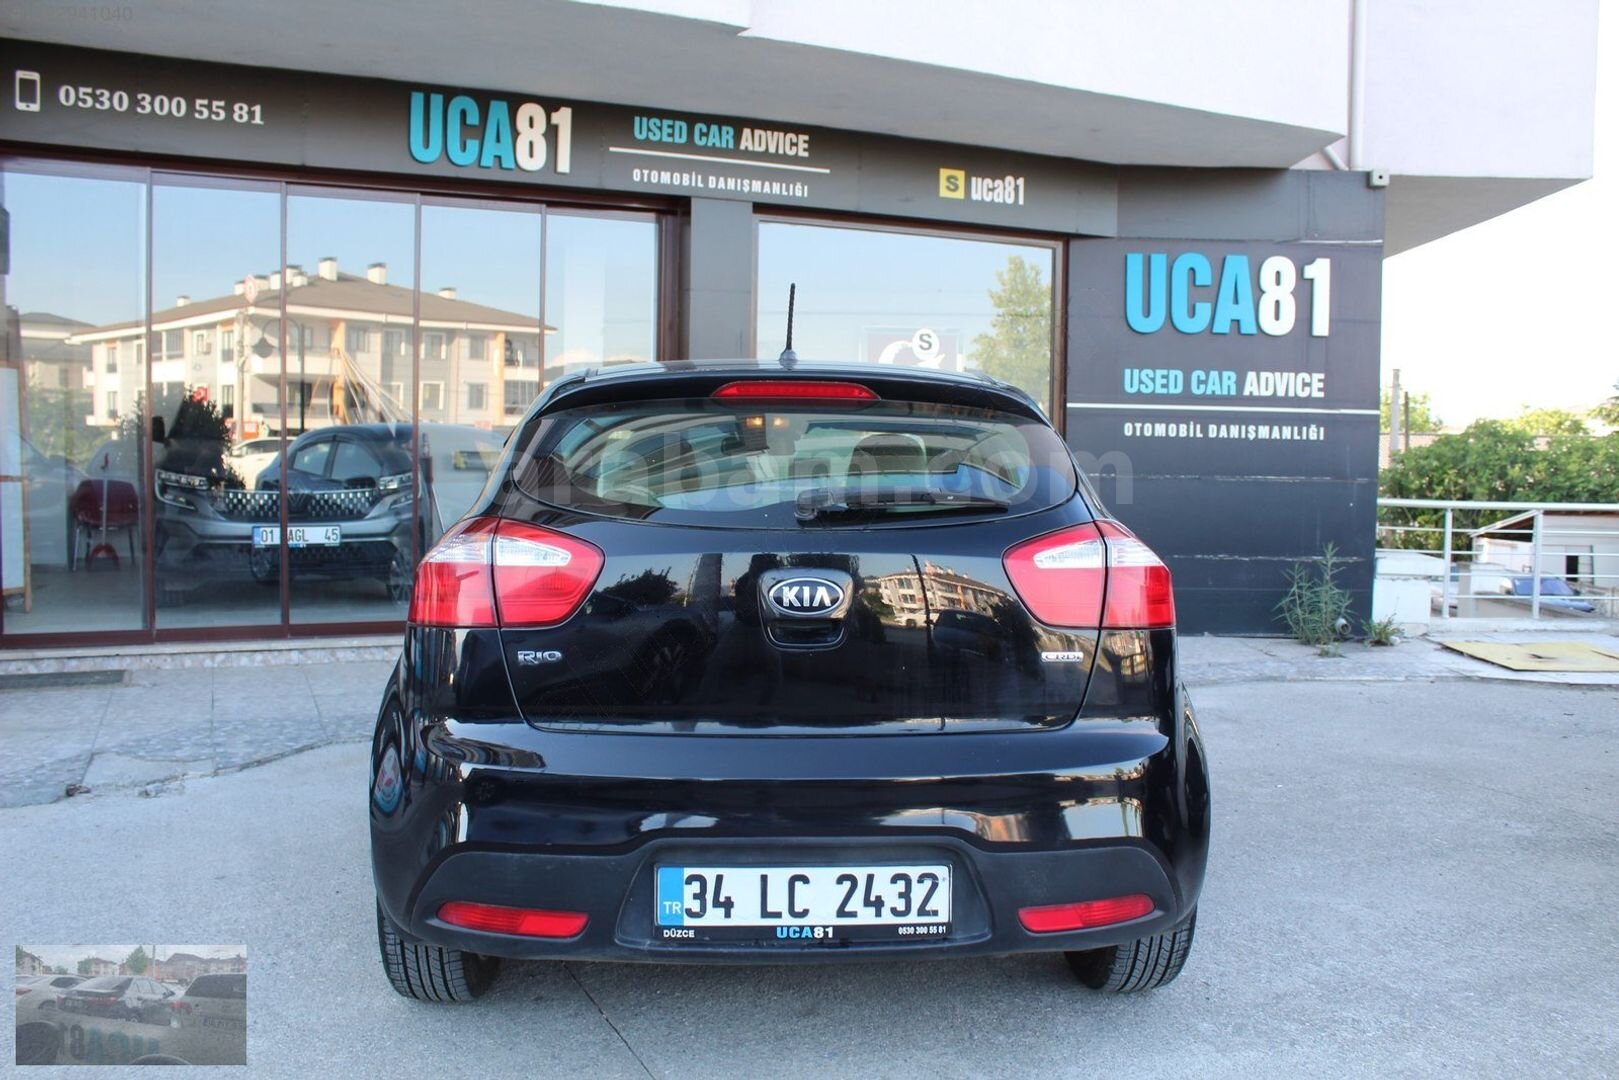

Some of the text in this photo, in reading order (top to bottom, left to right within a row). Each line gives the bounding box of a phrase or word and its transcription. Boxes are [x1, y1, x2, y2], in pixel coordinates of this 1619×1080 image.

[58, 84, 265, 125] 0530 300 55 81
[408, 91, 573, 174] UCA81
[633, 115, 810, 157] USED CAR ADVICE
[632, 167, 809, 198] OTOMOBİL DANIŞMANLIĞI
[945, 174, 1025, 205] S uca81
[1124, 252, 1331, 337] UCA81
[1124, 368, 1325, 398] USED CAR ADVICE
[1124, 421, 1325, 441] OTOMOBİL DANIŞMANLIĞI
[261, 528, 339, 542] 01 AGL 45
[782, 585, 832, 607] KIA
[517, 650, 562, 664] RIO
[663, 872, 940, 918] TR 34 LC 2432
[663, 928, 695, 938] DÜZCE
[776, 926, 834, 938] UCA81
